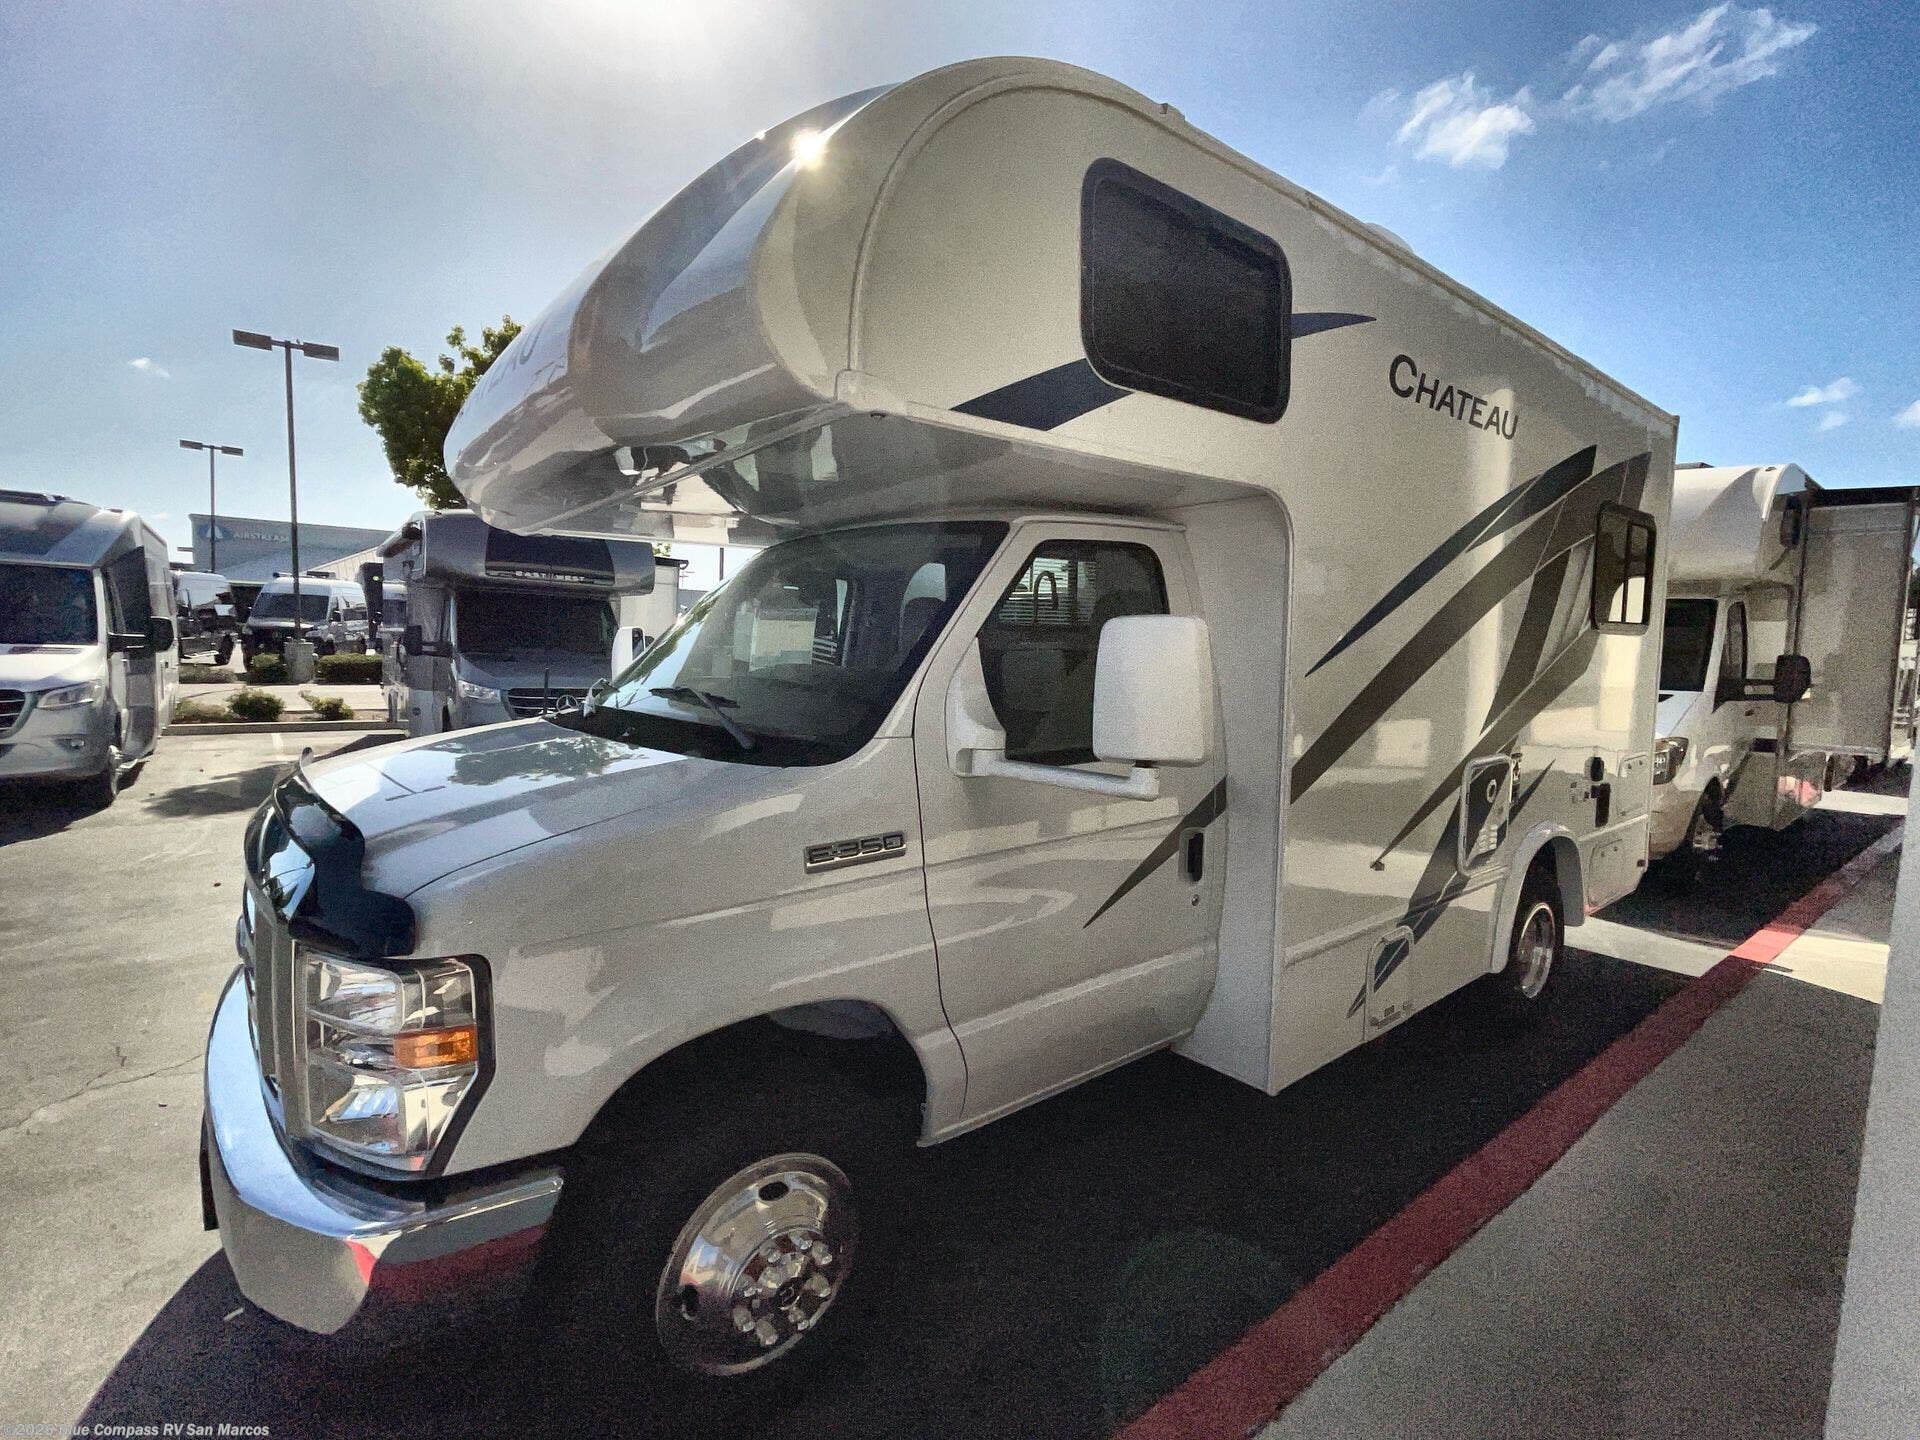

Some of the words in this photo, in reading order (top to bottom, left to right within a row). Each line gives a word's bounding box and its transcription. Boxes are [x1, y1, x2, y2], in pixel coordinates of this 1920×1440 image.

[1389, 353, 1519, 440] CHATEAU
[515, 570, 546, 578] EAST
[555, 574, 585, 582] WEST
[807, 833, 905, 864] E-350
